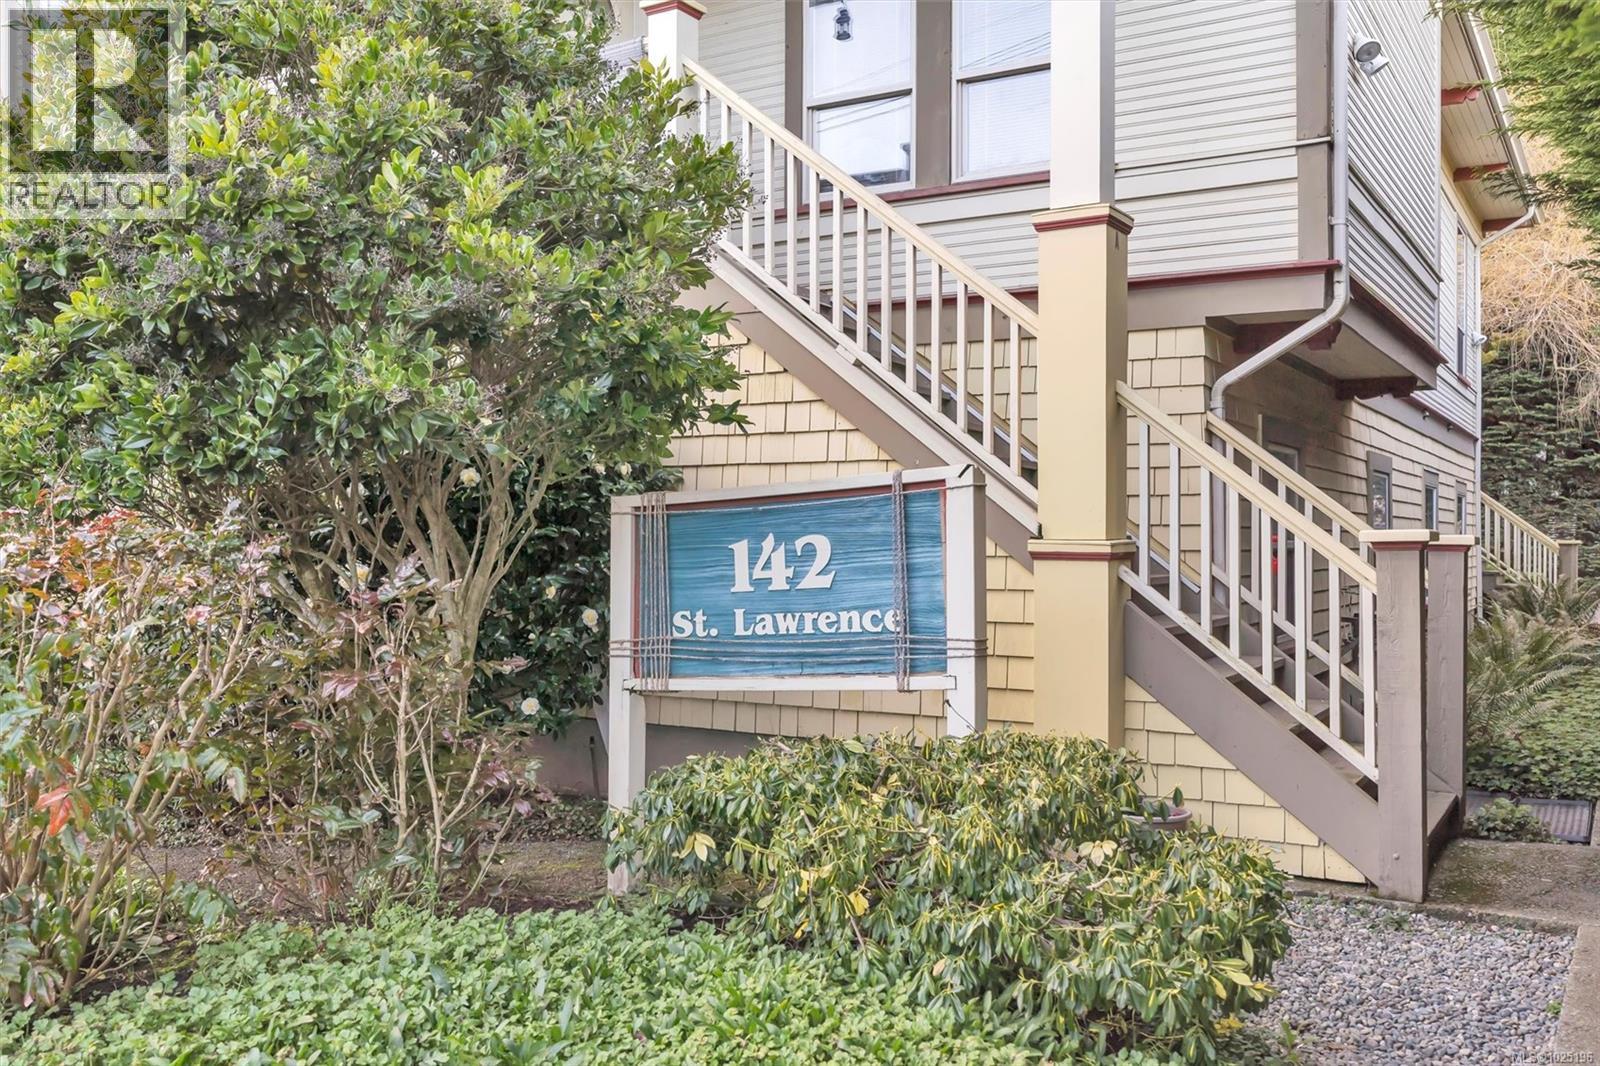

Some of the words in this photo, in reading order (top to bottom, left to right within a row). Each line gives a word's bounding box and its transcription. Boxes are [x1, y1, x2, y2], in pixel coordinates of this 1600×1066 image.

[728, 532, 836, 593] 142
[672, 609, 719, 638] St.
[733, 608, 902, 637] Lawrence
